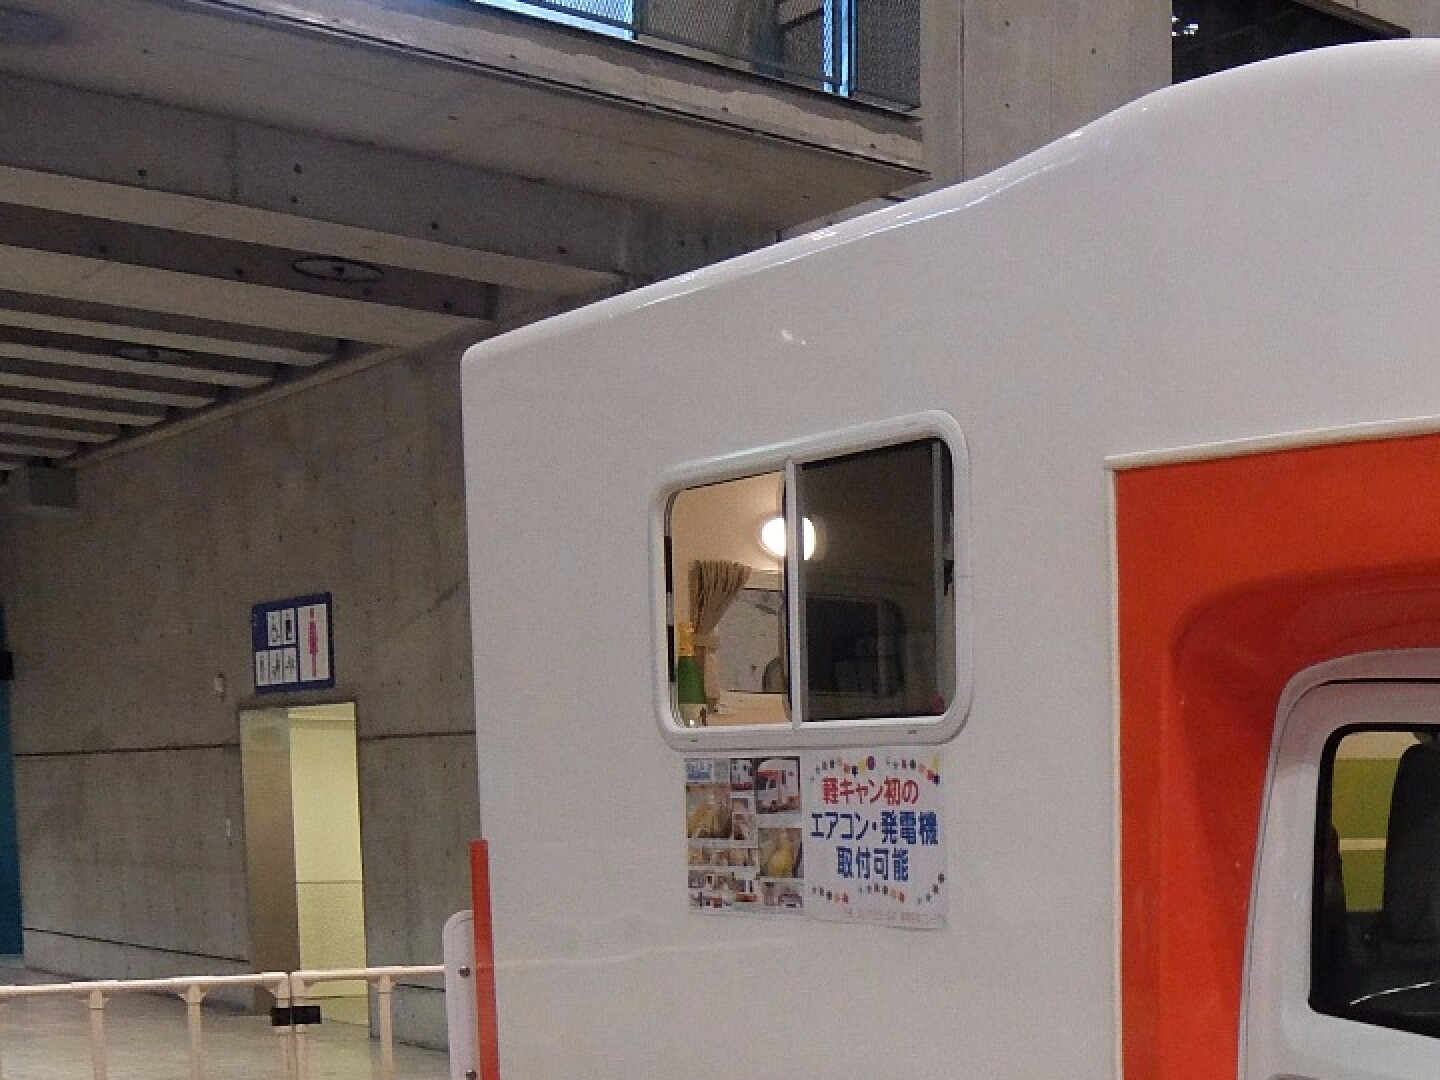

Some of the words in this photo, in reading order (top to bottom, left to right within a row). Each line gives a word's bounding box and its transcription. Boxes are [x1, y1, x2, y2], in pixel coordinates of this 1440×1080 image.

[821, 776, 920, 805] 軽キャン初の
[810, 810, 939, 846] エアコン・発電機
[835, 845, 910, 882] 取付可能
